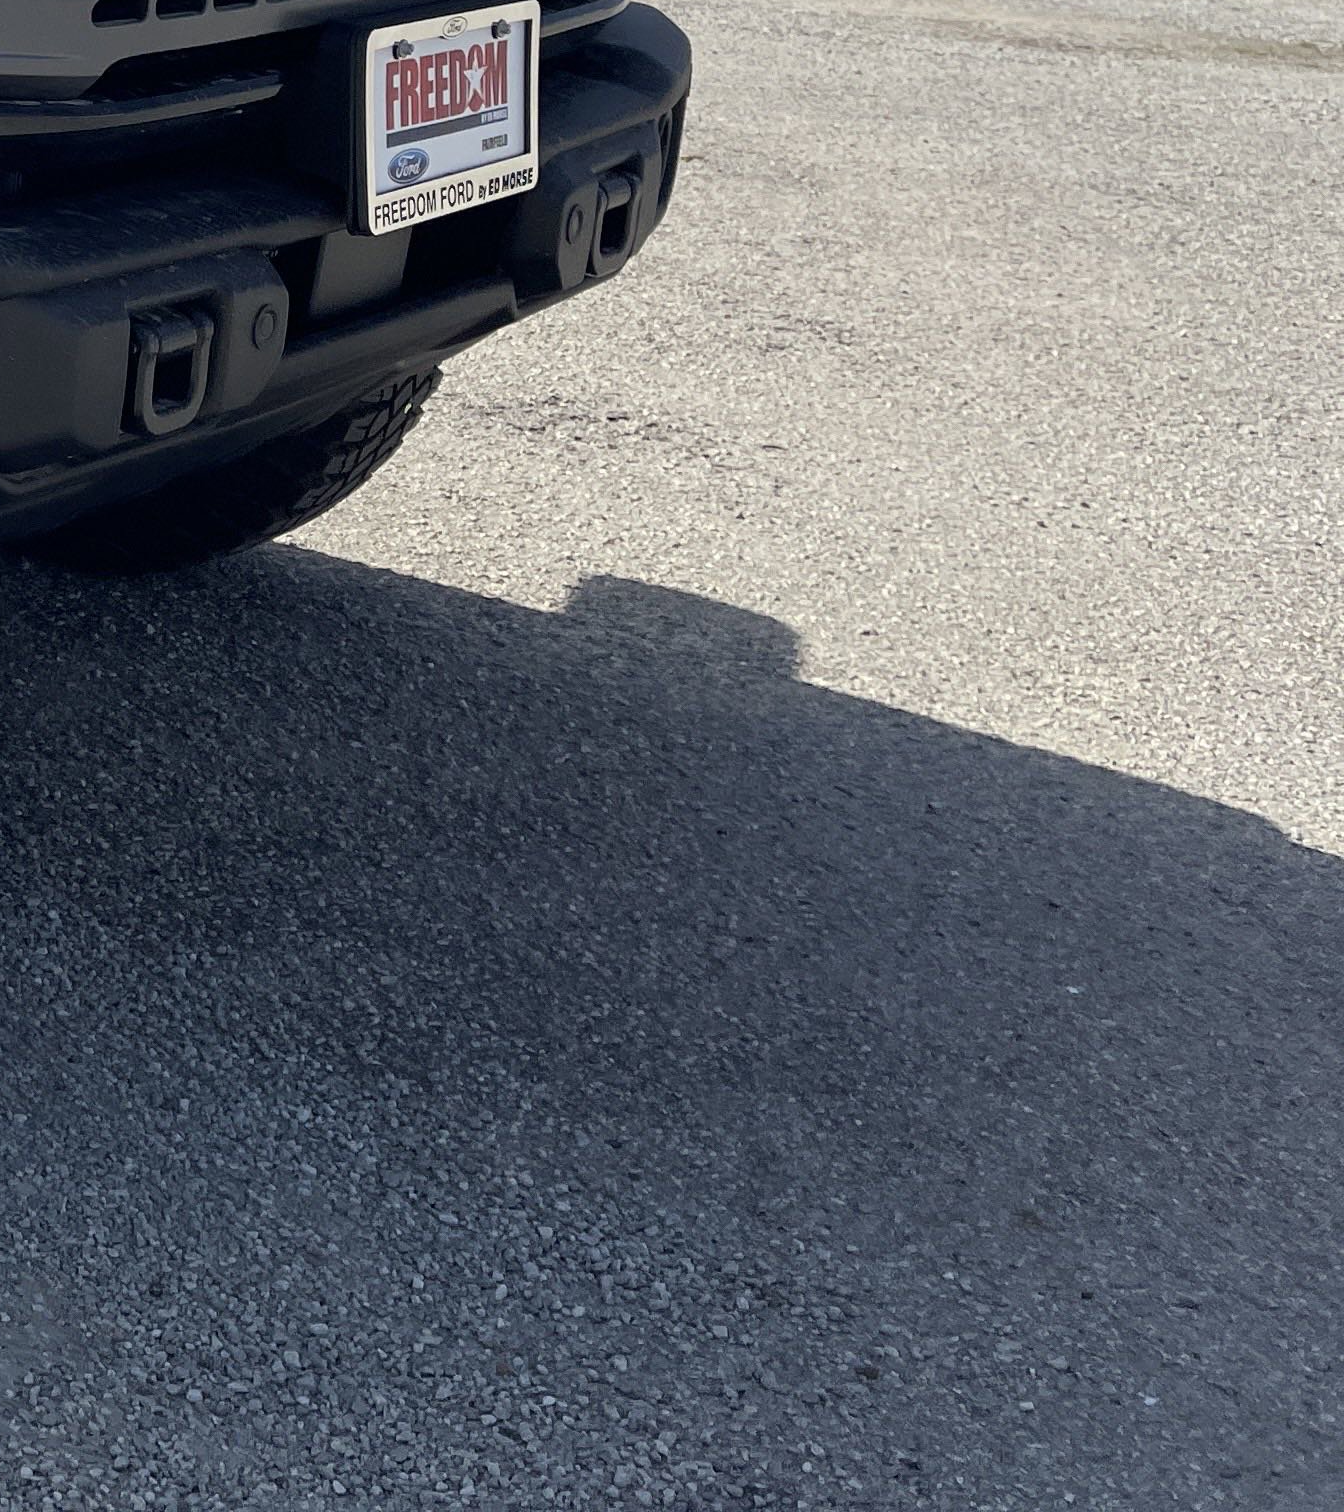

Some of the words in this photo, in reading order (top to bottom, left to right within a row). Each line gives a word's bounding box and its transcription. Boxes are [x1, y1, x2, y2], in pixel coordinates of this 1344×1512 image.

[386, 40, 508, 131] FREEDOM
[395, 154, 422, 179] Ford
[374, 191, 437, 230] FREEDOM
[440, 180, 474, 209] FORD
[488, 177, 500, 196] ED
[501, 167, 534, 191] MORSE
